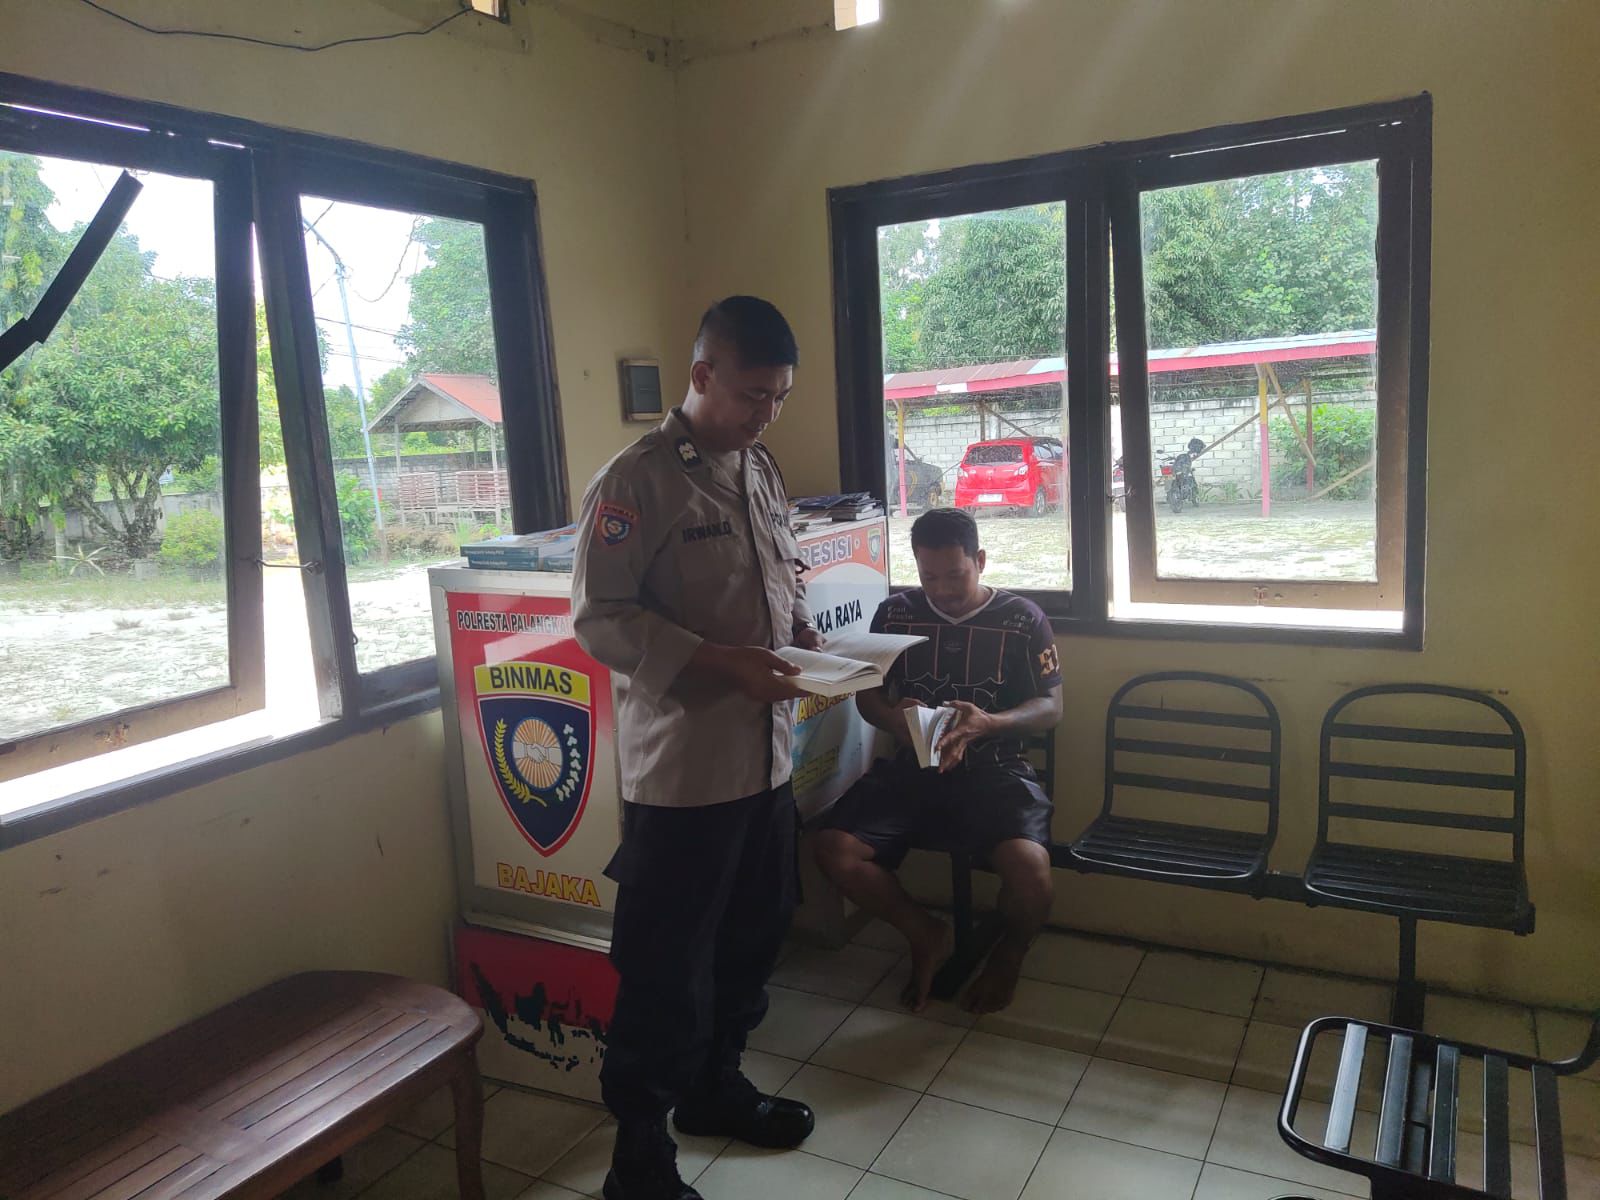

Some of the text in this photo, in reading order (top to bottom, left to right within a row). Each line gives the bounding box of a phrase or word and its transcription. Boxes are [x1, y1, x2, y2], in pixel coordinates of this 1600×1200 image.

[457, 611, 509, 632] POLRESTA
[835, 599, 863, 629] RAYA
[489, 666, 573, 695] BINMAS
[496, 862, 602, 907] BAJAKA
